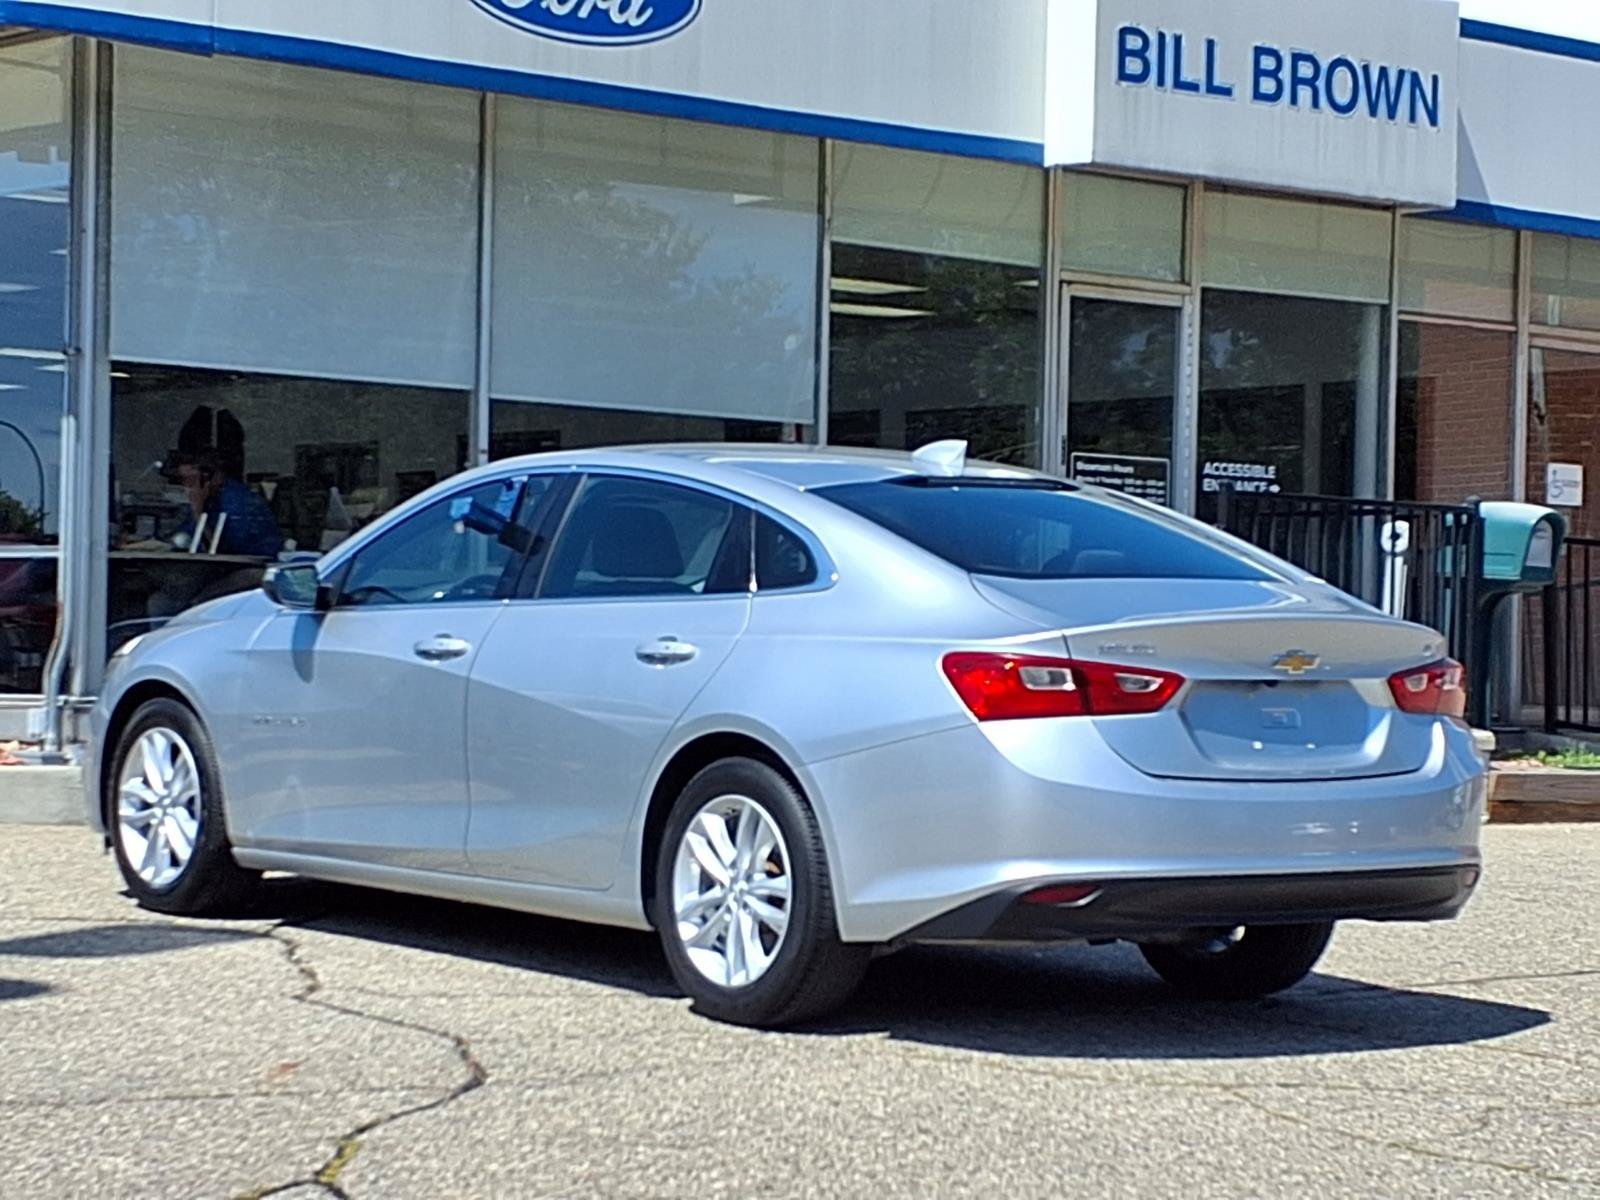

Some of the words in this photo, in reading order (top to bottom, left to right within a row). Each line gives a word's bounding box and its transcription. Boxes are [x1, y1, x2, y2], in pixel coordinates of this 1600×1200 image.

[1116, 25, 1234, 98] BILL
[1252, 44, 1439, 127] BROWN
[1203, 462, 1276, 479] ACCESSIBLE
